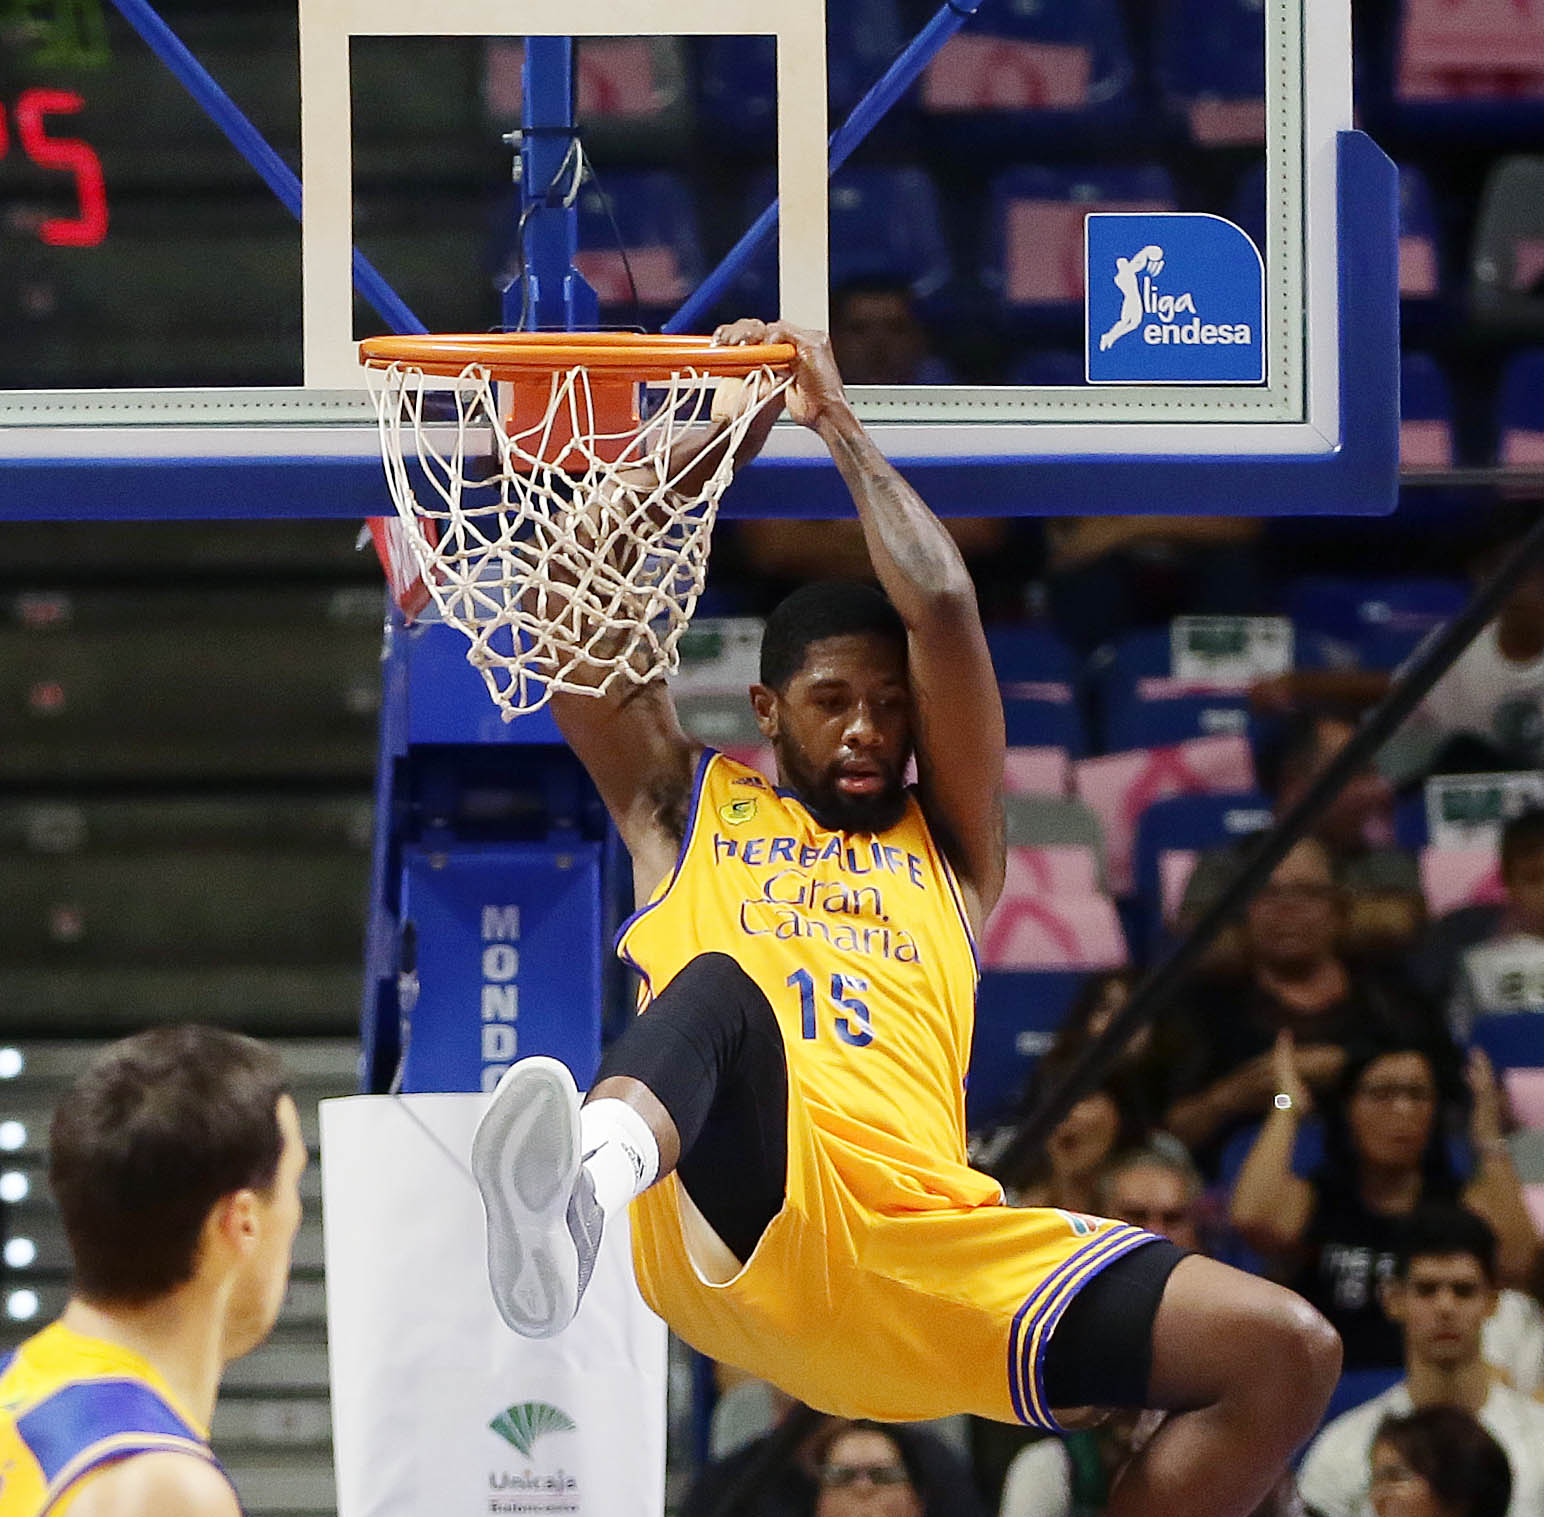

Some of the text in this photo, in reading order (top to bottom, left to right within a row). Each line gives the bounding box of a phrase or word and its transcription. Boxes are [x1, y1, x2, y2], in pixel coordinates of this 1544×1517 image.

[1143, 276, 1197, 323] liga
[1143, 317, 1252, 345] endesa
[713, 832, 926, 891] HERBALIFE
[739, 898, 922, 965] Canaria
[786, 967, 876, 1048] 15
